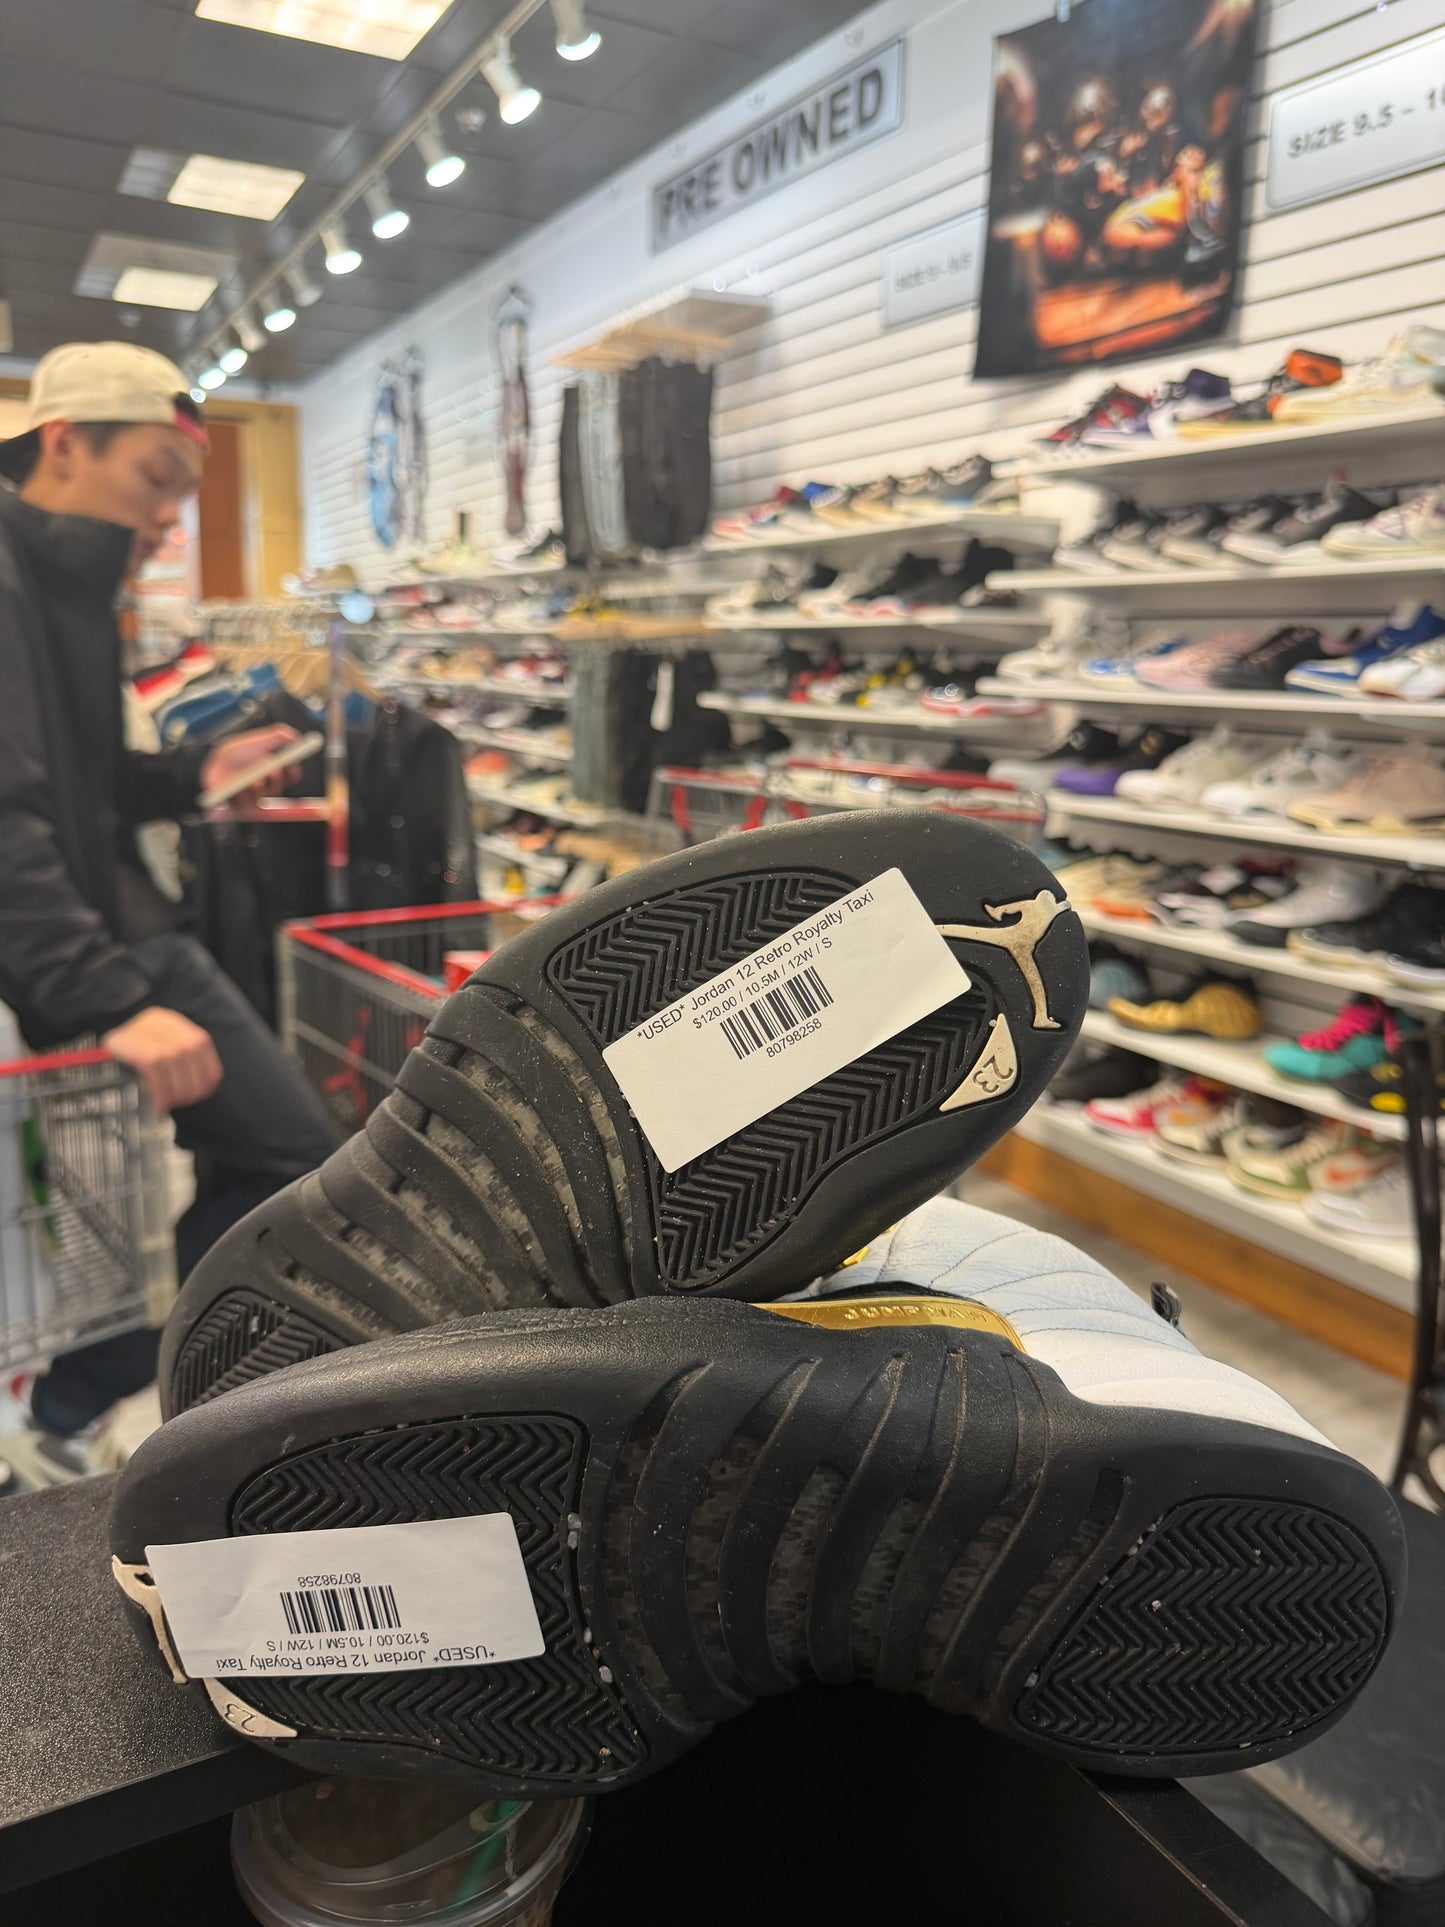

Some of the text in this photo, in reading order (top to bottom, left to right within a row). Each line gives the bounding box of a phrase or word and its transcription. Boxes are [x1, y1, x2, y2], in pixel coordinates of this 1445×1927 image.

[1287, 119, 1346, 159] SIZE
[1427, 83, 1445, 113] 1
[658, 67, 884, 234] PRE OWNED
[691, 978, 735, 1011] Jordan
[736, 963, 755, 981] 12
[754, 941, 793, 970] Retro
[792, 909, 844, 946] Royalty
[843, 889, 875, 914] Taxi
[692, 996, 737, 1030] $120.00
[745, 968, 781, 995] 10.5M
[788, 948, 814, 971] 12W
[822, 937, 833, 949] S
[766, 1018, 823, 1058] 80798258
[973, 1054, 1013, 1093] 23
[843, 1305, 988, 1323] JUMPMAN
[297, 1572, 362, 1588] 80798258
[266, 1639, 276, 1651] S
[287, 1638, 315, 1651] 12W
[326, 1636, 366, 1649] 10.5M
[376, 1631, 430, 1647] $120.00
[216, 1657, 246, 1671] Taxi
[249, 1654, 302, 1670] Royalty
[306, 1654, 348, 1668] Retro
[352, 1653, 369, 1667] 12
[374, 1650, 427, 1665] Jordan
[225, 1703, 257, 1733] 23
